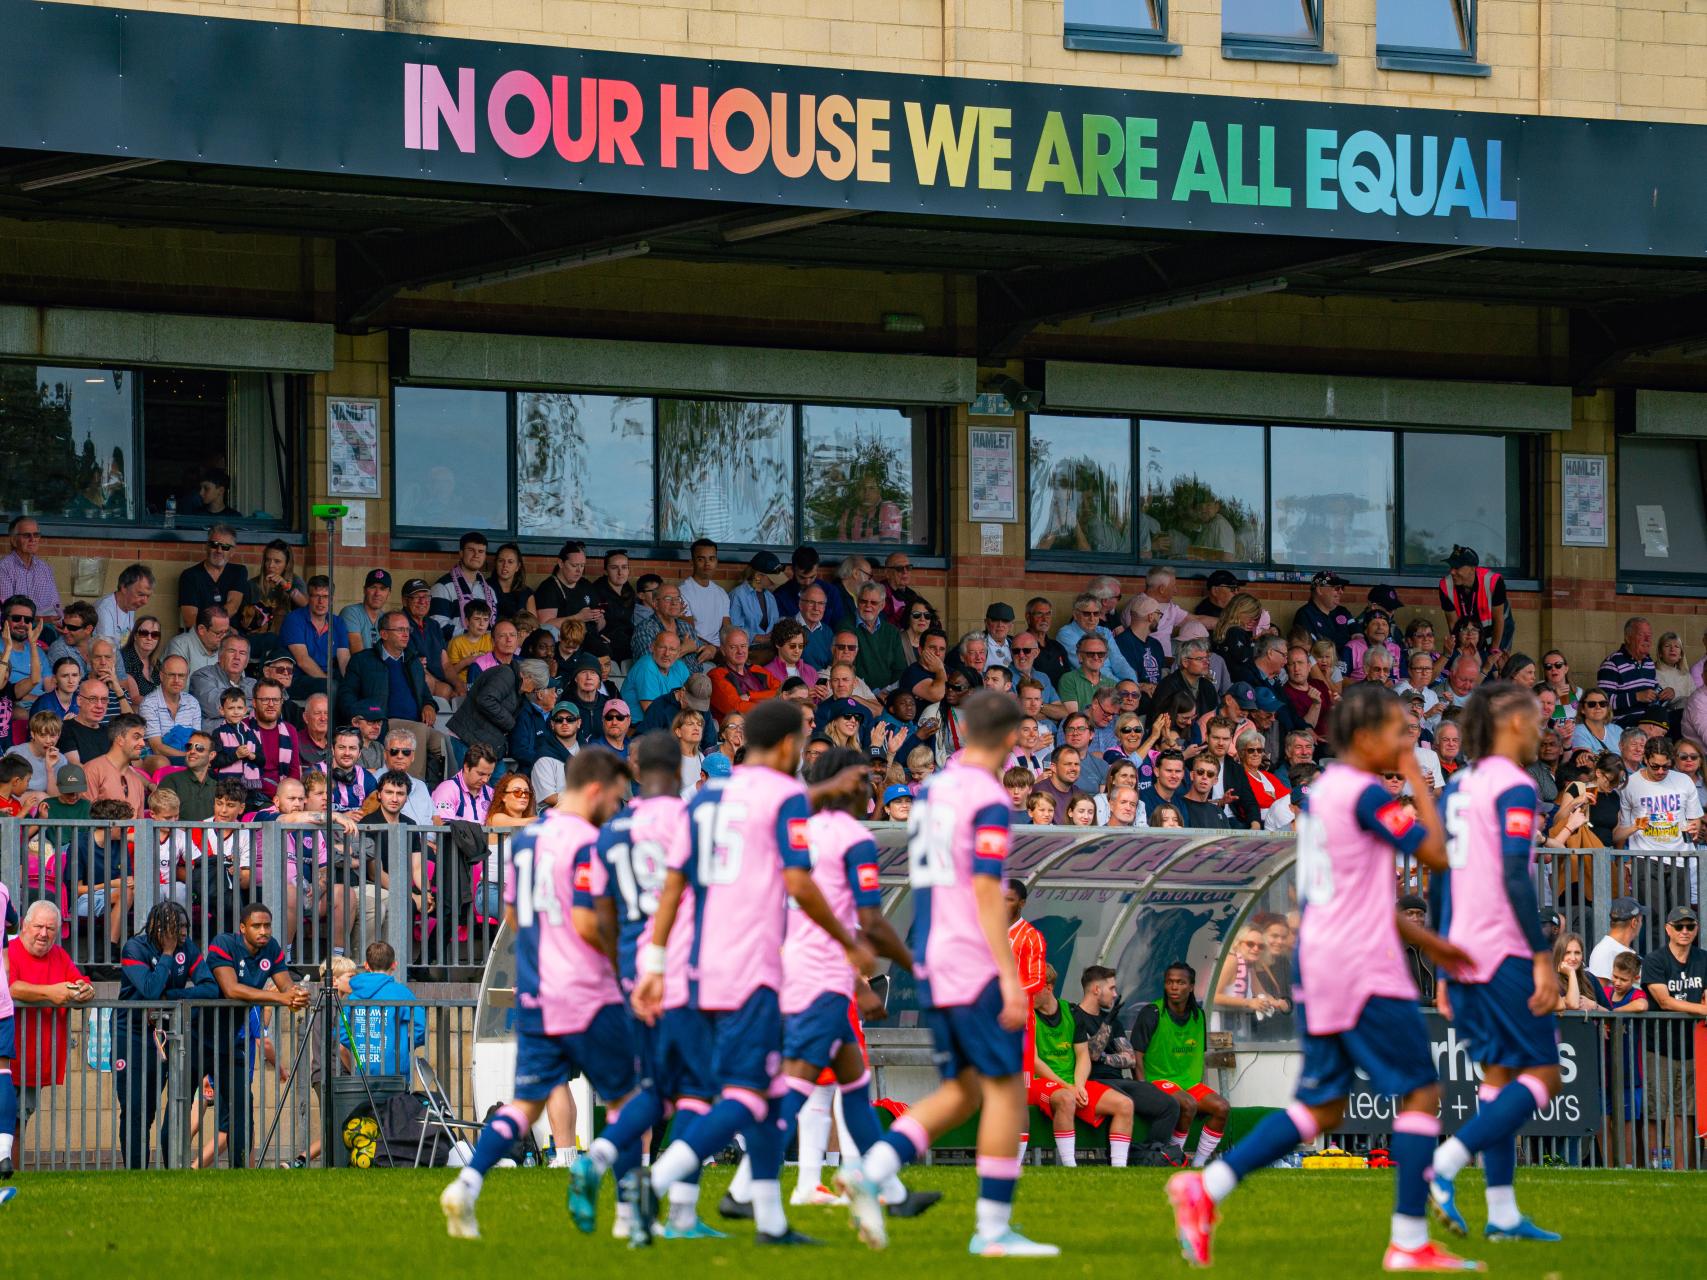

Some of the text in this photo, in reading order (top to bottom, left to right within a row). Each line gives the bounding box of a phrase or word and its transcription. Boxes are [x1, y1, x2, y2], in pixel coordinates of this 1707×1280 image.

[405, 63, 1516, 220] IN OUR HOUSE WE ARE ALL EQUAL
[972, 431, 1010, 449] HAMLET
[1565, 460, 1602, 476] HAMLET
[694, 802, 748, 886] 15
[1640, 794, 1680, 815] FRANCE
[514, 848, 563, 927] 14
[606, 841, 669, 920] 19
